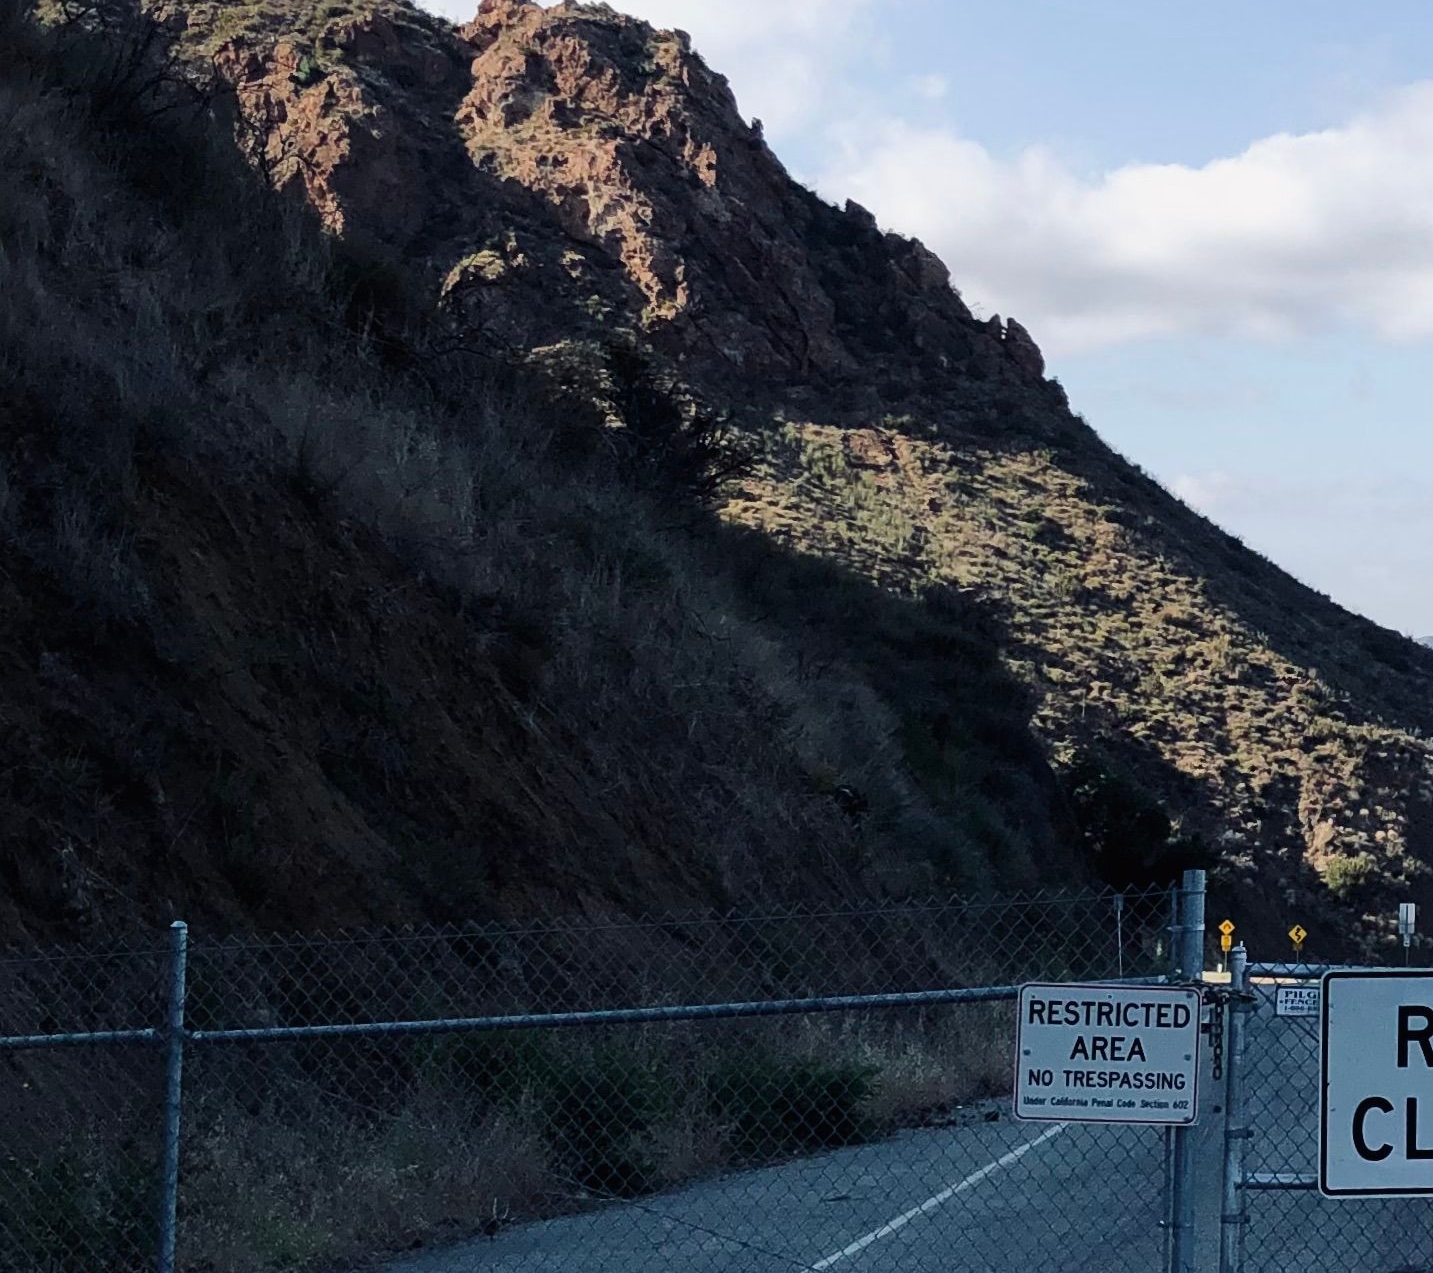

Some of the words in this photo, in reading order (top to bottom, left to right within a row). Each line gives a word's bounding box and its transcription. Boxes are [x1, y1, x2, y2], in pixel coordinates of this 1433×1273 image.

[1028, 999, 1191, 1029] RESTRICTED
[1069, 1035, 1147, 1062] AREA
[1027, 1069, 1054, 1087] NO
[1062, 1069, 1186, 1091] TRESPASSING
[1023, 1095, 1047, 1106] Under
[1050, 1096, 1089, 1107] California
[1091, 1097, 1114, 1108] Penal
[1116, 1098, 1136, 1109] Code
[1140, 1099, 1170, 1110] Section
[1172, 1099, 1189, 1110] 602
